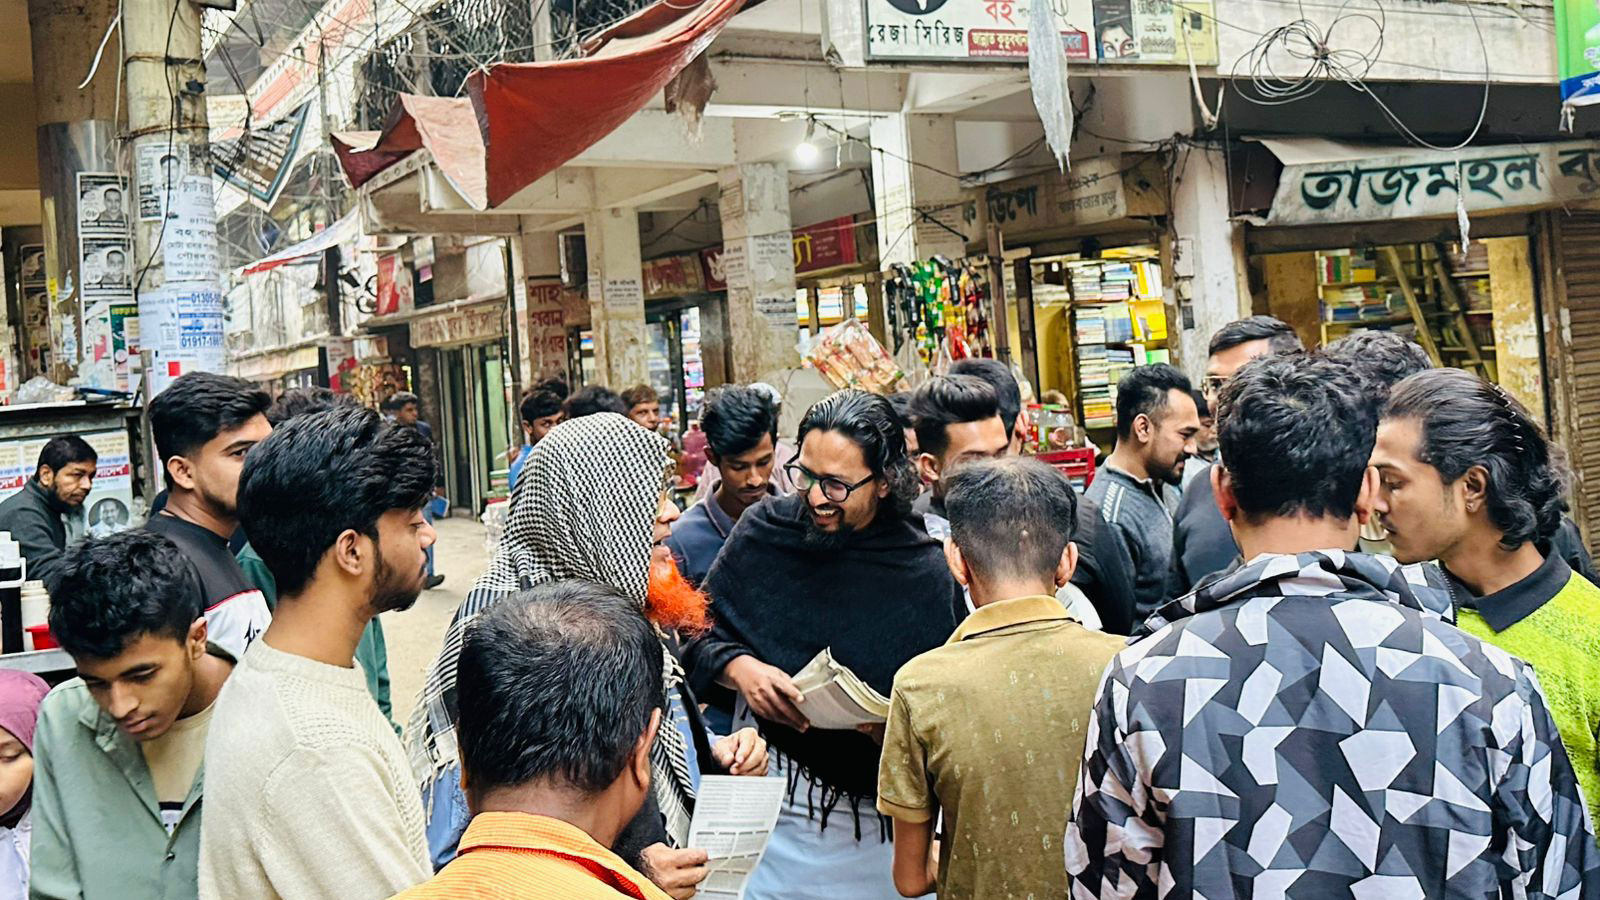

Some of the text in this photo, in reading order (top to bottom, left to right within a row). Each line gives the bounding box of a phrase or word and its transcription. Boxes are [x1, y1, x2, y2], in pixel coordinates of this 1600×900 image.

[868, 18, 965, 46] রেজা সিরিজ
[1301, 153, 1542, 210] তাজমহল
[986, 184, 1038, 224] ডিপো
